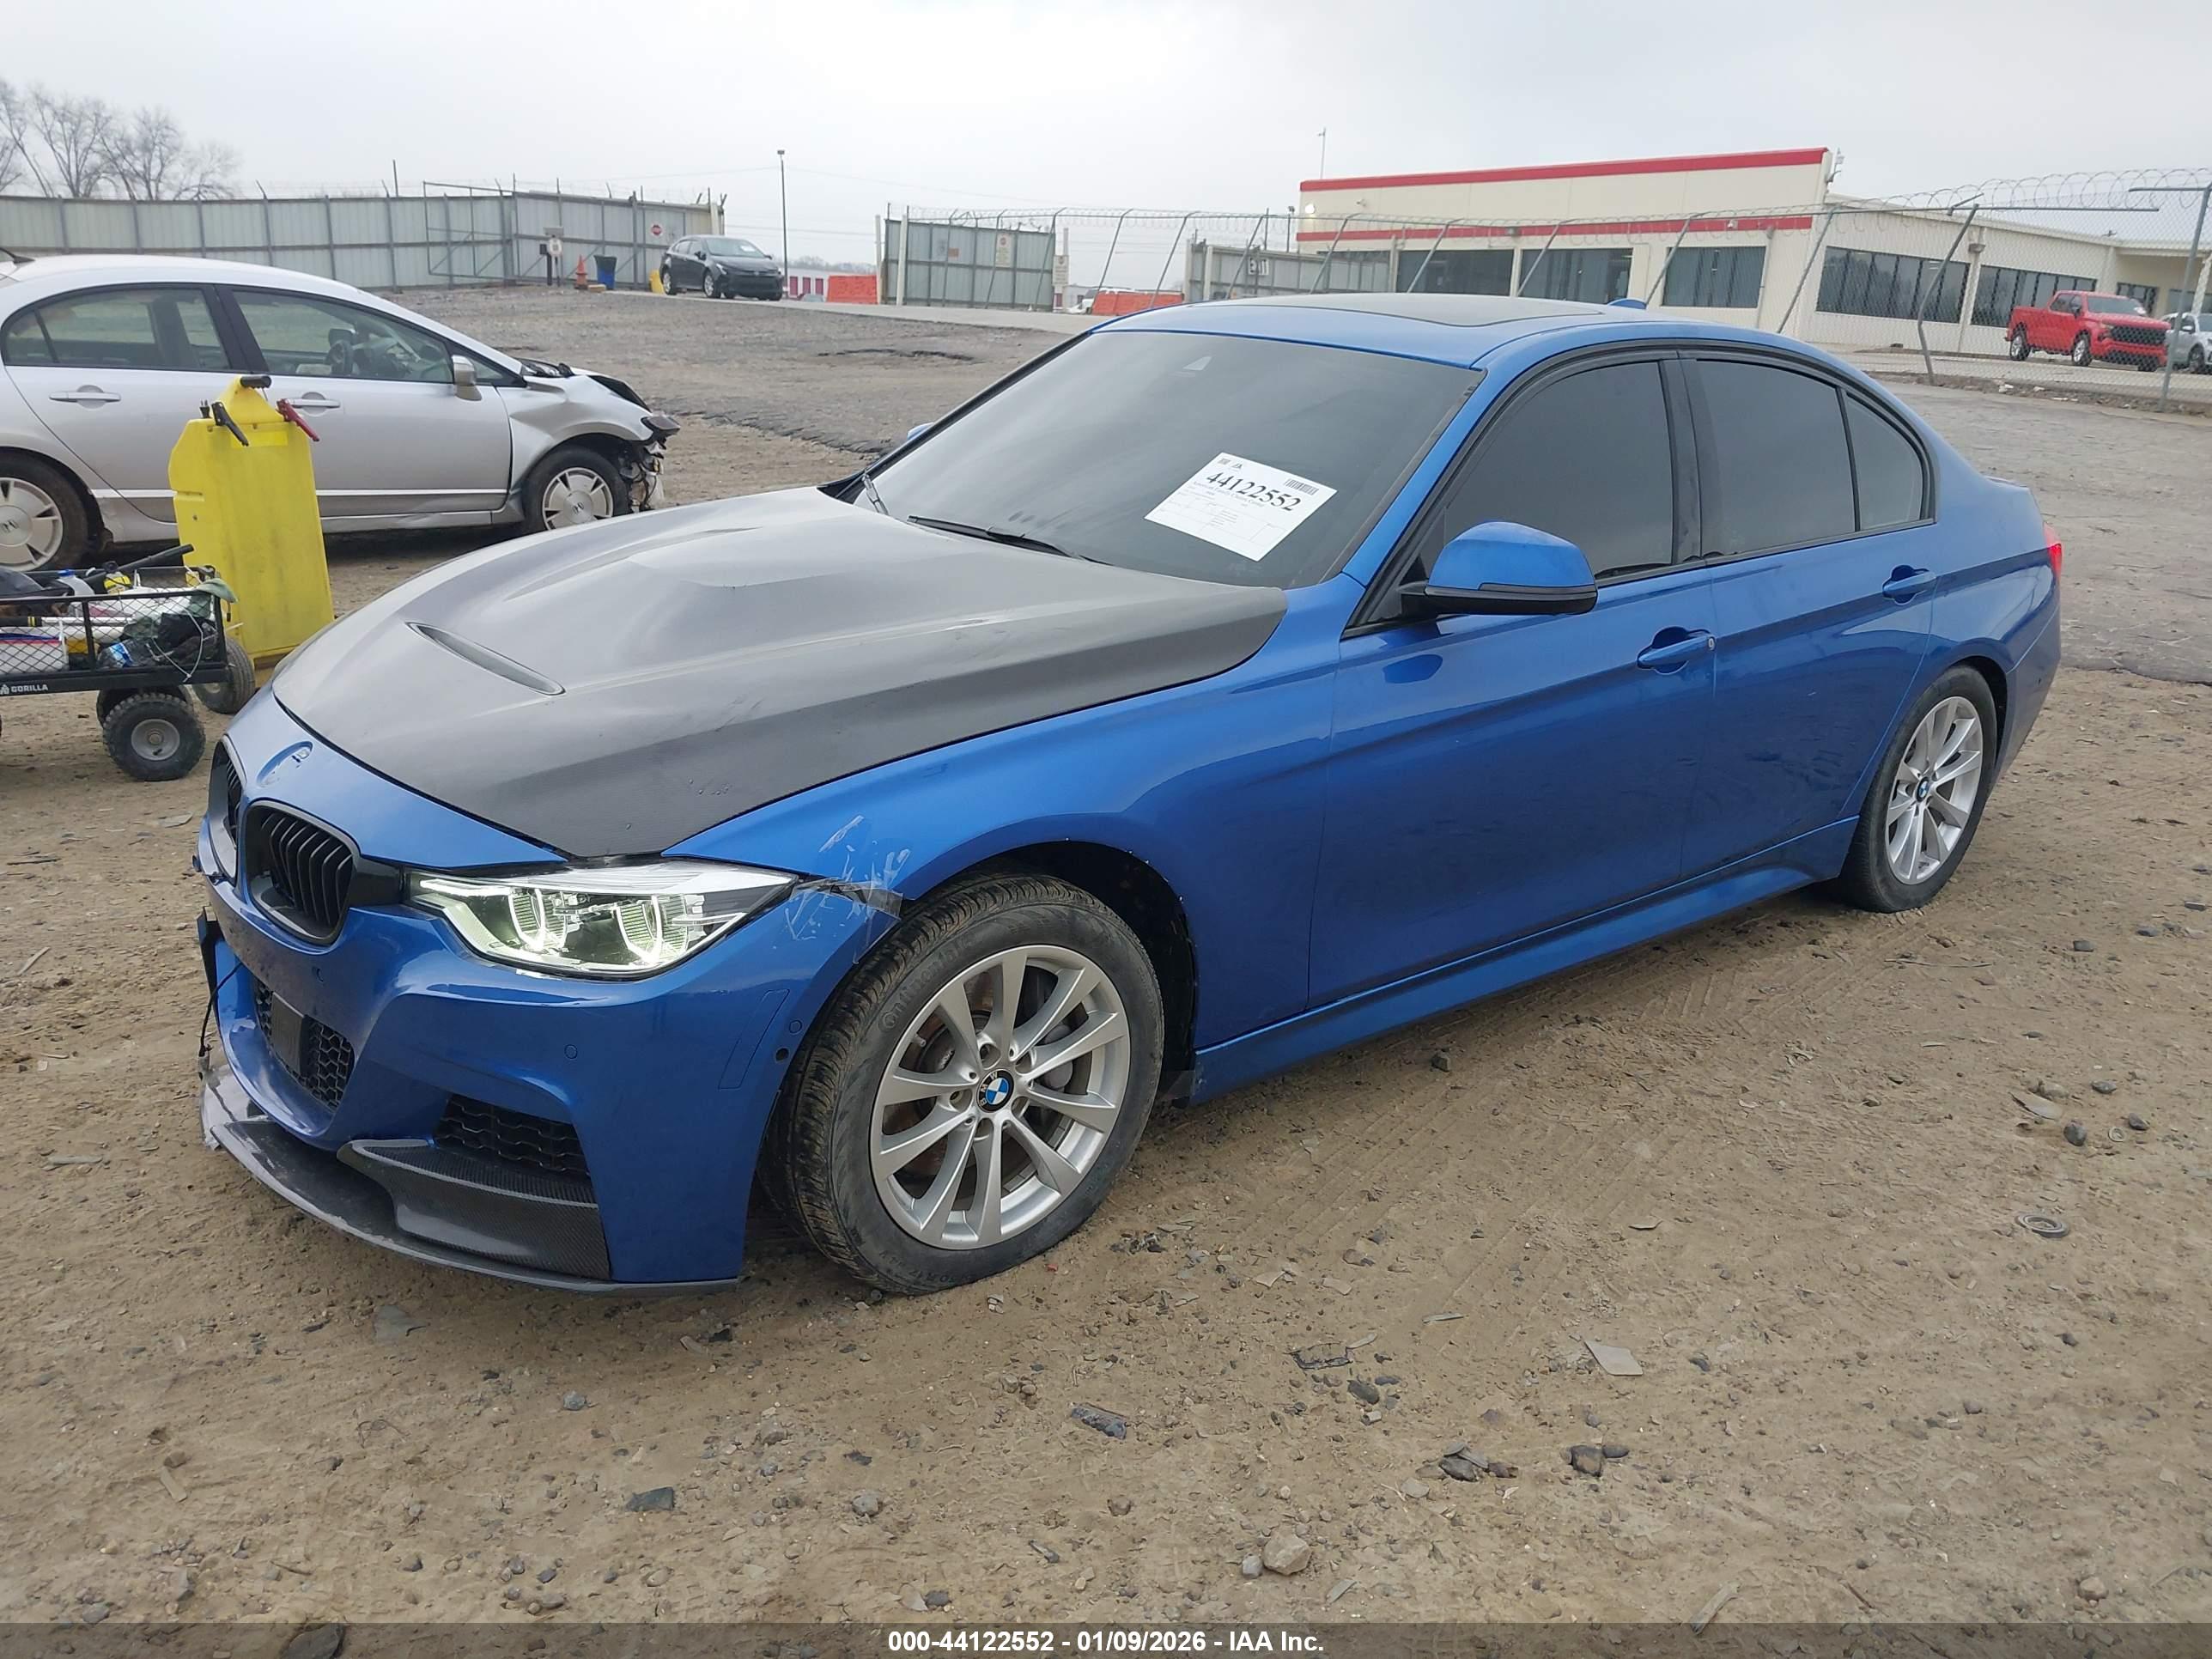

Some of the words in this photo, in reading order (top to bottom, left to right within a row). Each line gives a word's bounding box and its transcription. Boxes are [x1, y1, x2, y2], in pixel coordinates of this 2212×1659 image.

[1206, 472, 1301, 512] 44122552
[11, 684, 48, 693] GORILLA
[979, 1071, 999, 1107] BMW
